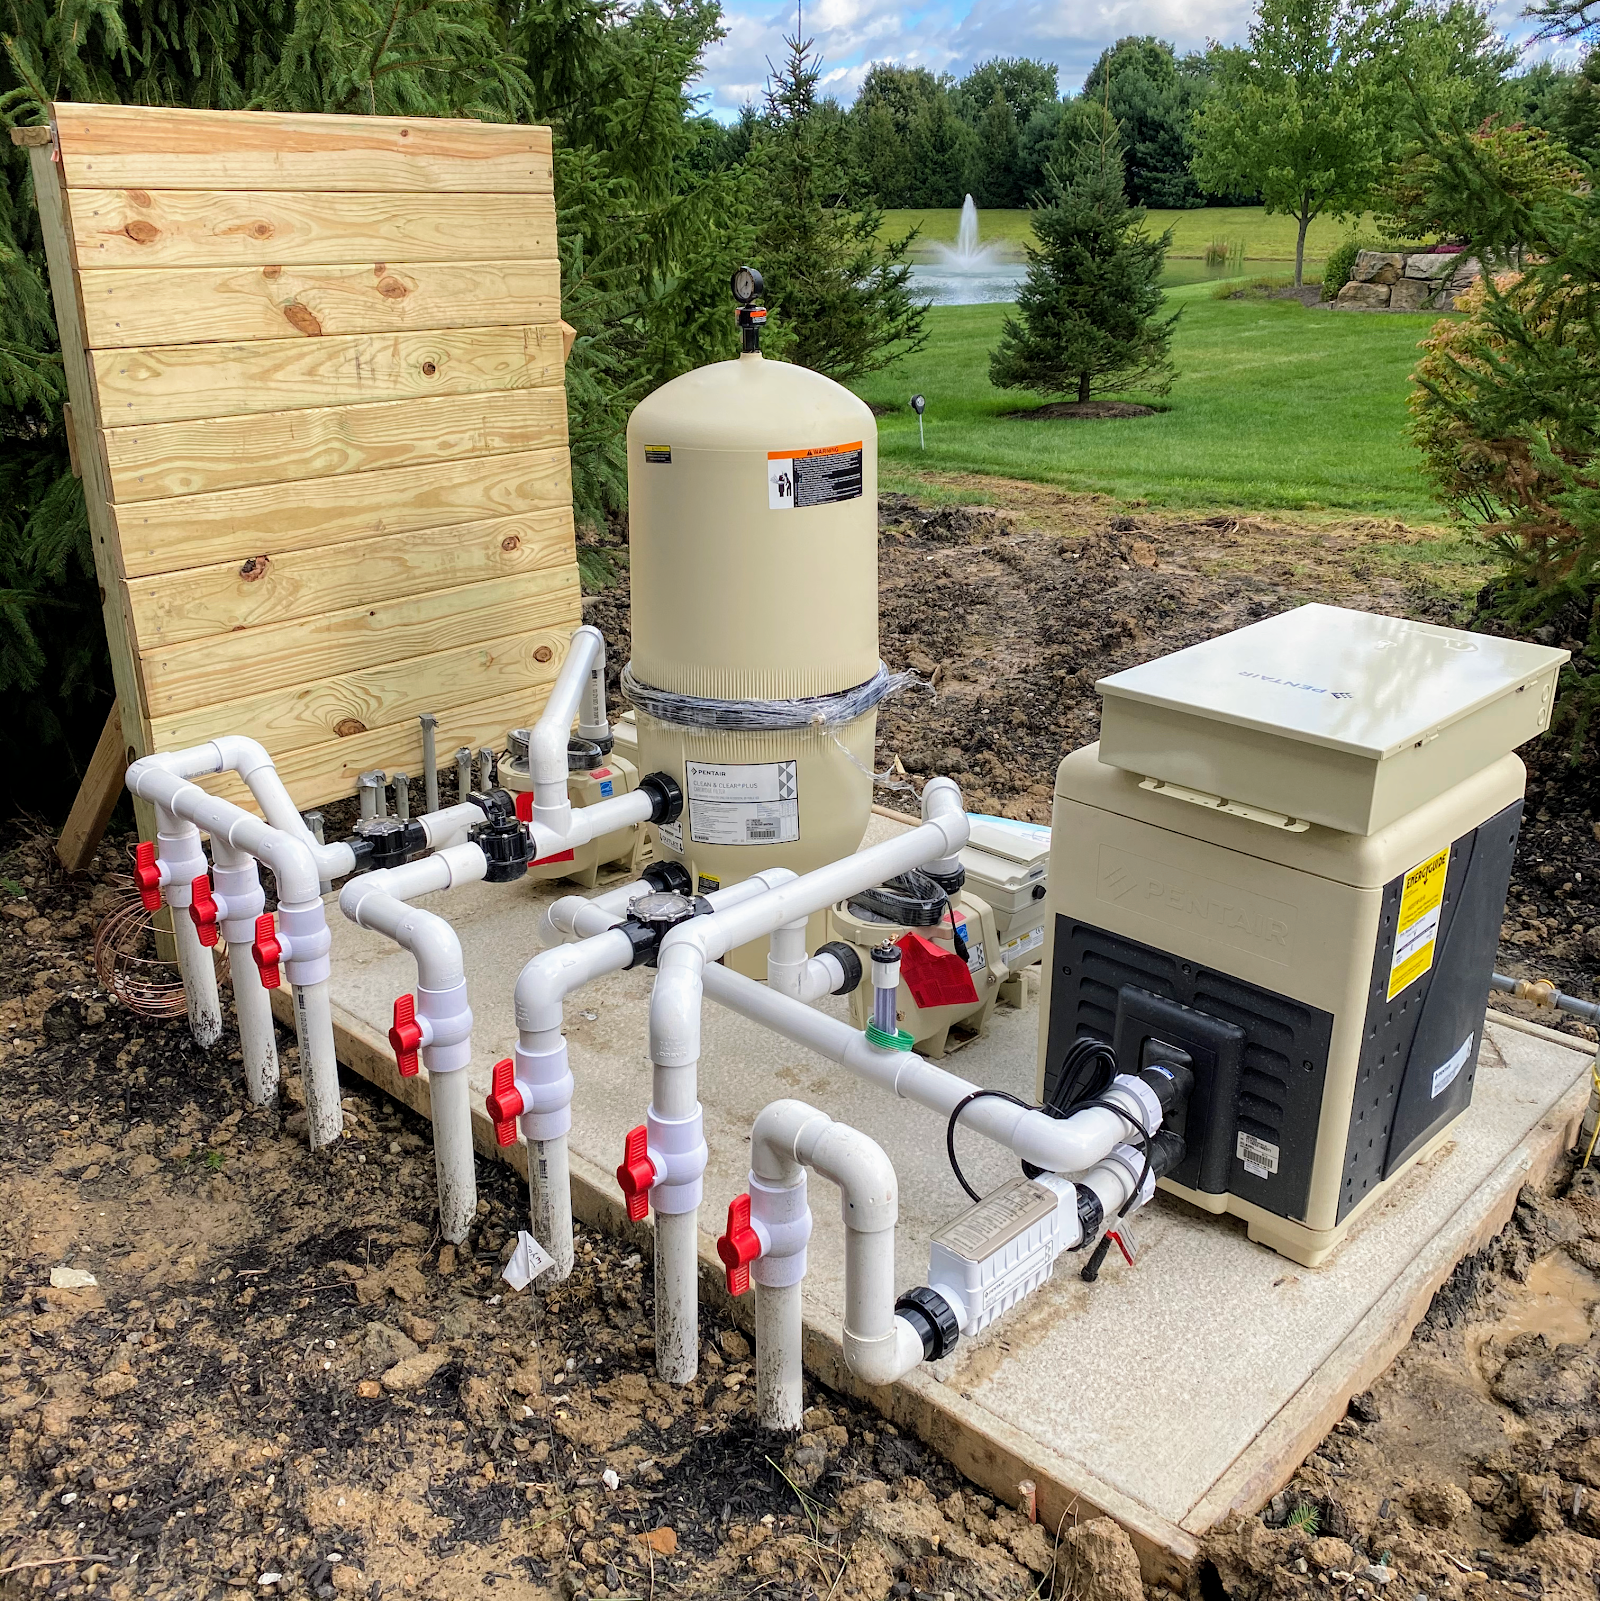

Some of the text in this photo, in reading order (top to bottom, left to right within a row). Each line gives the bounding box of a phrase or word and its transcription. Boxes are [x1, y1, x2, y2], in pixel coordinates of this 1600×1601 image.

[813, 447, 839, 455] WARNING
[1238, 670, 1328, 694] PENTAIR
[698, 769, 726, 777] PENTAIR
[693, 780, 712, 788] CLEAN
[1144, 876, 1289, 947] PENTAIR
